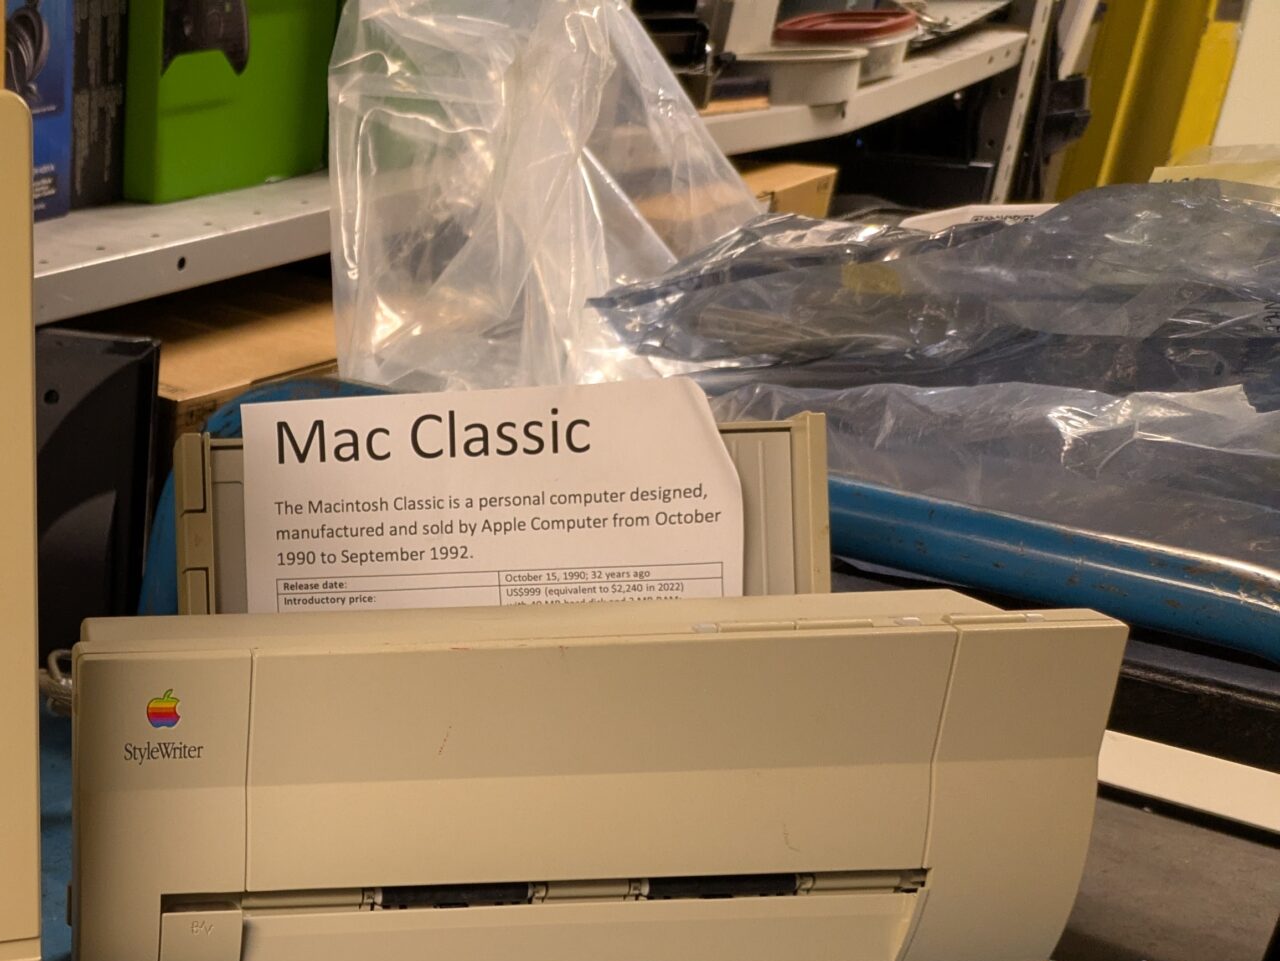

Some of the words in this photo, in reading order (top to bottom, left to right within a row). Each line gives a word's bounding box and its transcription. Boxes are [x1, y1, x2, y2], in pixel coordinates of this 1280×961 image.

[277, 420, 391, 465] Mac
[411, 408, 590, 459] Classic
[274, 500, 303, 515] The
[308, 497, 388, 514] Macintosh
[393, 496, 444, 511] Classic
[449, 495, 460, 509] is
[465, 498, 473, 509] a
[479, 491, 545, 511] personal
[550, 490, 626, 507] computer
[630, 483, 707, 503] designed,
[276, 522, 384, 541] manufactured
[389, 521, 417, 536] and
[422, 520, 453, 535] sold
[459, 519, 477, 536] by
[481, 517, 526, 536] Apple
[531, 516, 608, 533] Computer
[612, 513, 650, 527] from
[655, 509, 722, 526] October
[277, 551, 316, 566] 1990
[320, 552, 337, 564] to
[341, 547, 425, 566] September
[430, 545, 473, 560] 1992.
[283, 582, 319, 591] Release
[322, 580, 347, 590] date:
[505, 573, 543, 583] October
[545, 573, 560, 583] 15,
[562, 571, 589, 582] 1990;
[590, 570, 603, 580] 32
[605, 570, 631, 580] years
[633, 569, 651, 580] ago
[506, 587, 541, 597] US$999
[544, 584, 597, 597] (equivalent
[599, 585, 609, 594] to
[610, 583, 643, 594] $2,240
[645, 582, 655, 592] in
[657, 581, 685, 593] 2022)
[283, 594, 348, 607] Introductory
[349, 593, 376, 606] price:
[123, 741, 204, 766] StyleWriter
